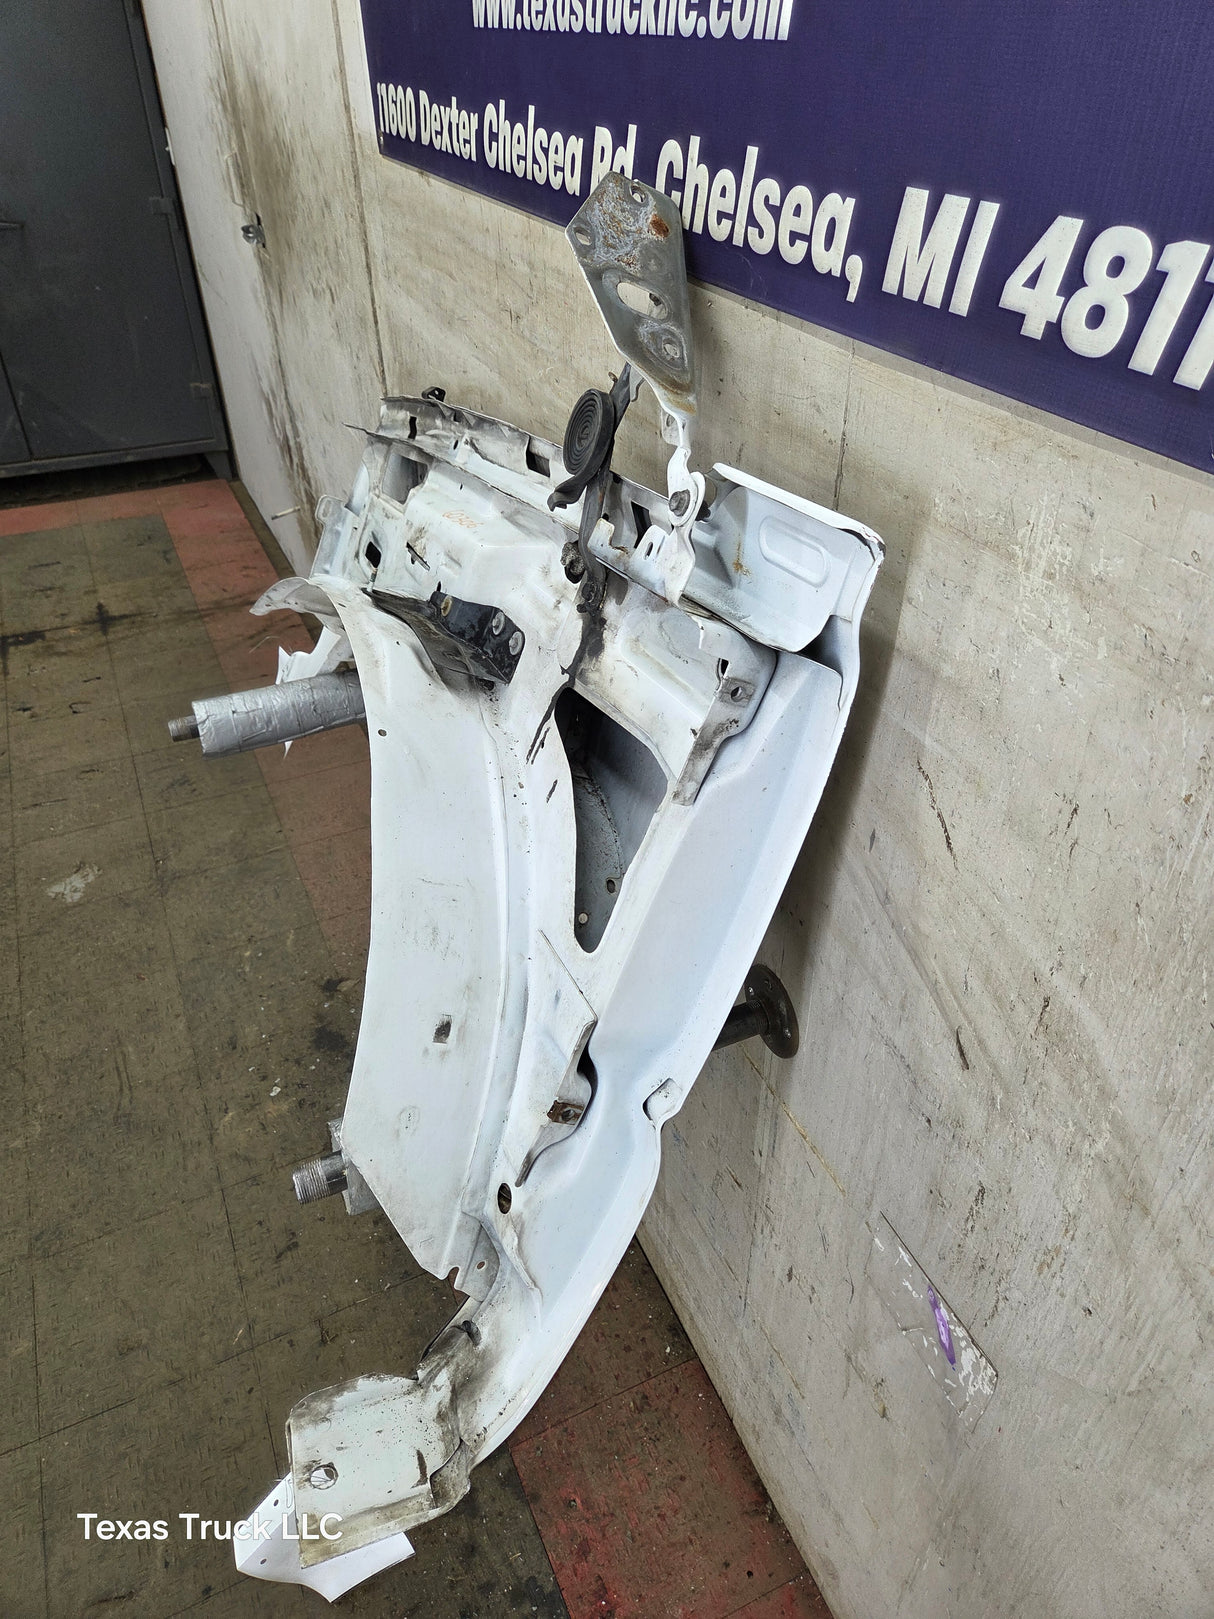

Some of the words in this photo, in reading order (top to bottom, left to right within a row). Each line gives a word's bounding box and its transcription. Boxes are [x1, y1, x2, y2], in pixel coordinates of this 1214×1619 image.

[376, 82, 417, 142] 11600
[419, 89, 479, 162] Dexter
[483, 98, 584, 197] Chelsea
[655, 134, 863, 303] Chelsea,
[881, 186, 1001, 317] MI
